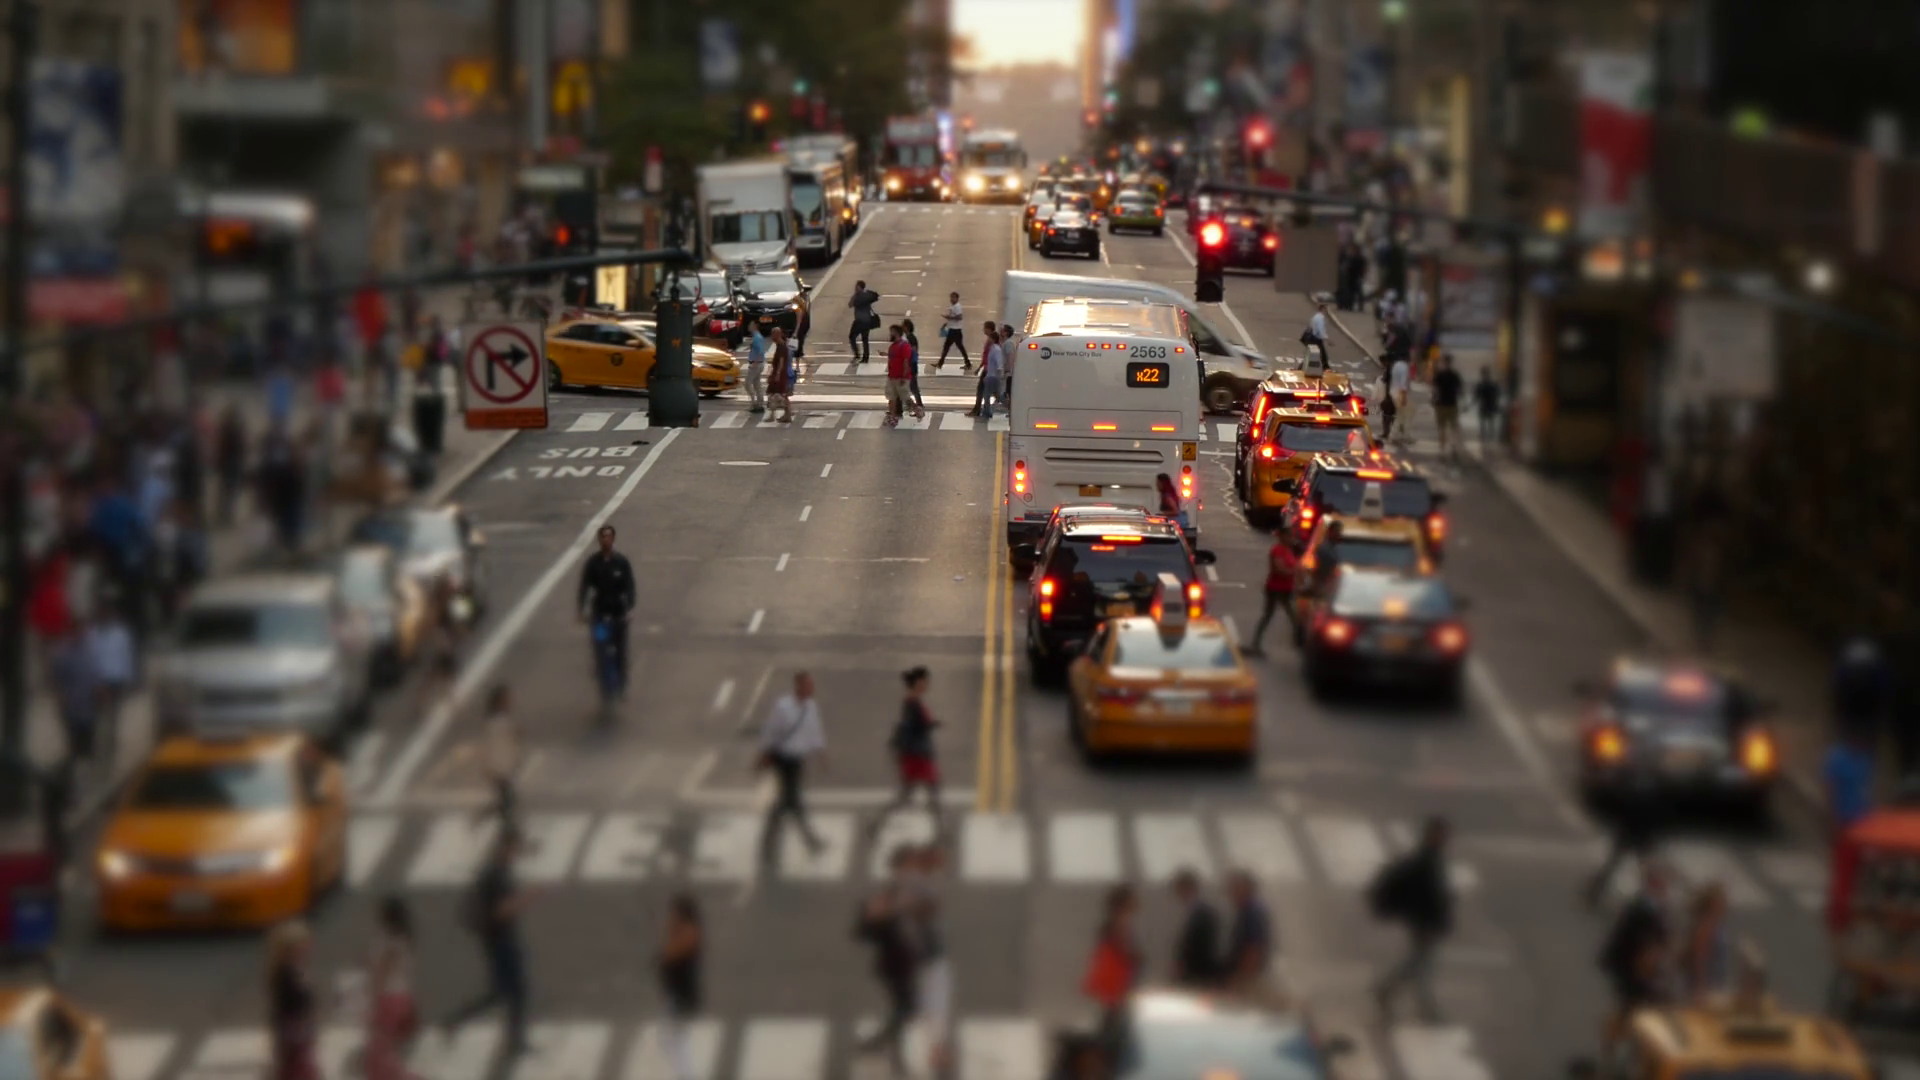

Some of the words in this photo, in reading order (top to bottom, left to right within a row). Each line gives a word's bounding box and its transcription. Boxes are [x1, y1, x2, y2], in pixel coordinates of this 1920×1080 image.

[1130, 346, 1166, 359] 2563
[539, 446, 638, 458] BUS
[491, 465, 625, 480] ONLY
